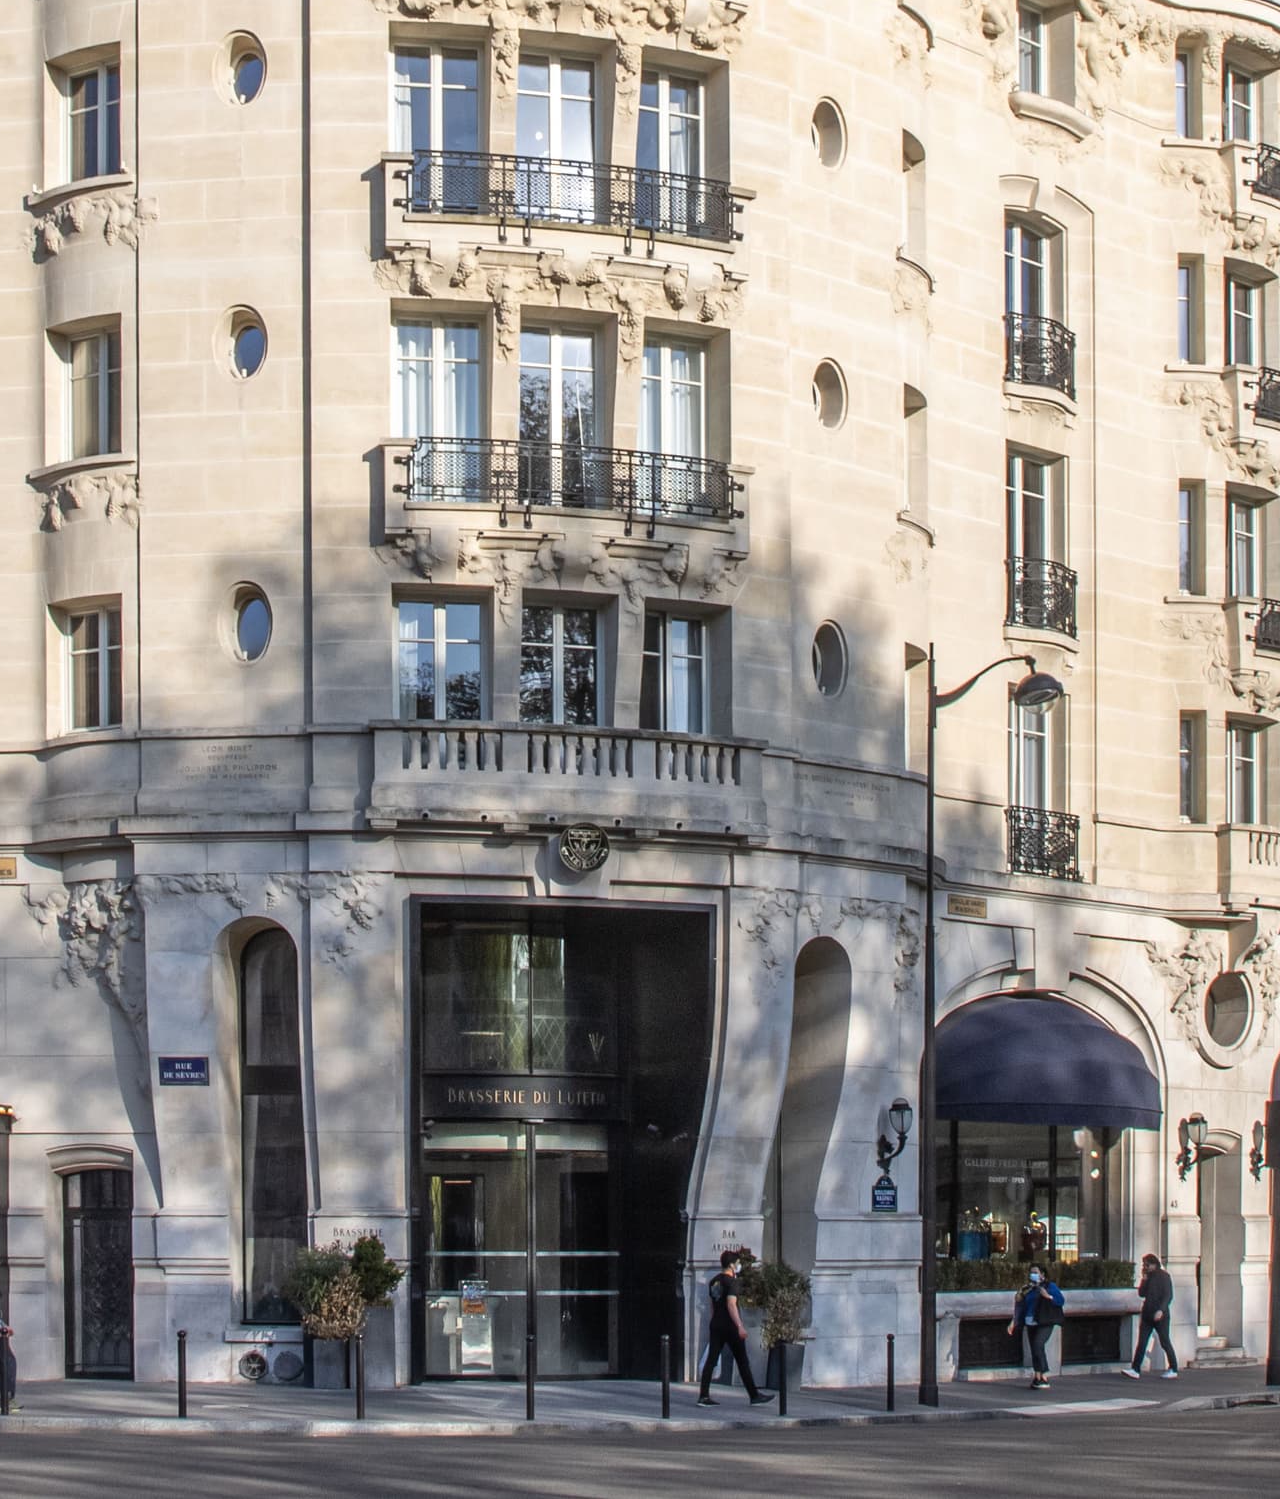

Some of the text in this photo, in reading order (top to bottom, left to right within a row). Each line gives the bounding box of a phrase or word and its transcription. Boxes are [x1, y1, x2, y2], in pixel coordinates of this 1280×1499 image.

[175, 1062, 192, 1070] RUE
[163, 1071, 174, 1079] DE
[448, 1087, 525, 1104] BRASSERIE
[533, 1089, 550, 1104] DU
[332, 1226, 384, 1238] BRASSERIE
[722, 1229, 736, 1239] BAR
